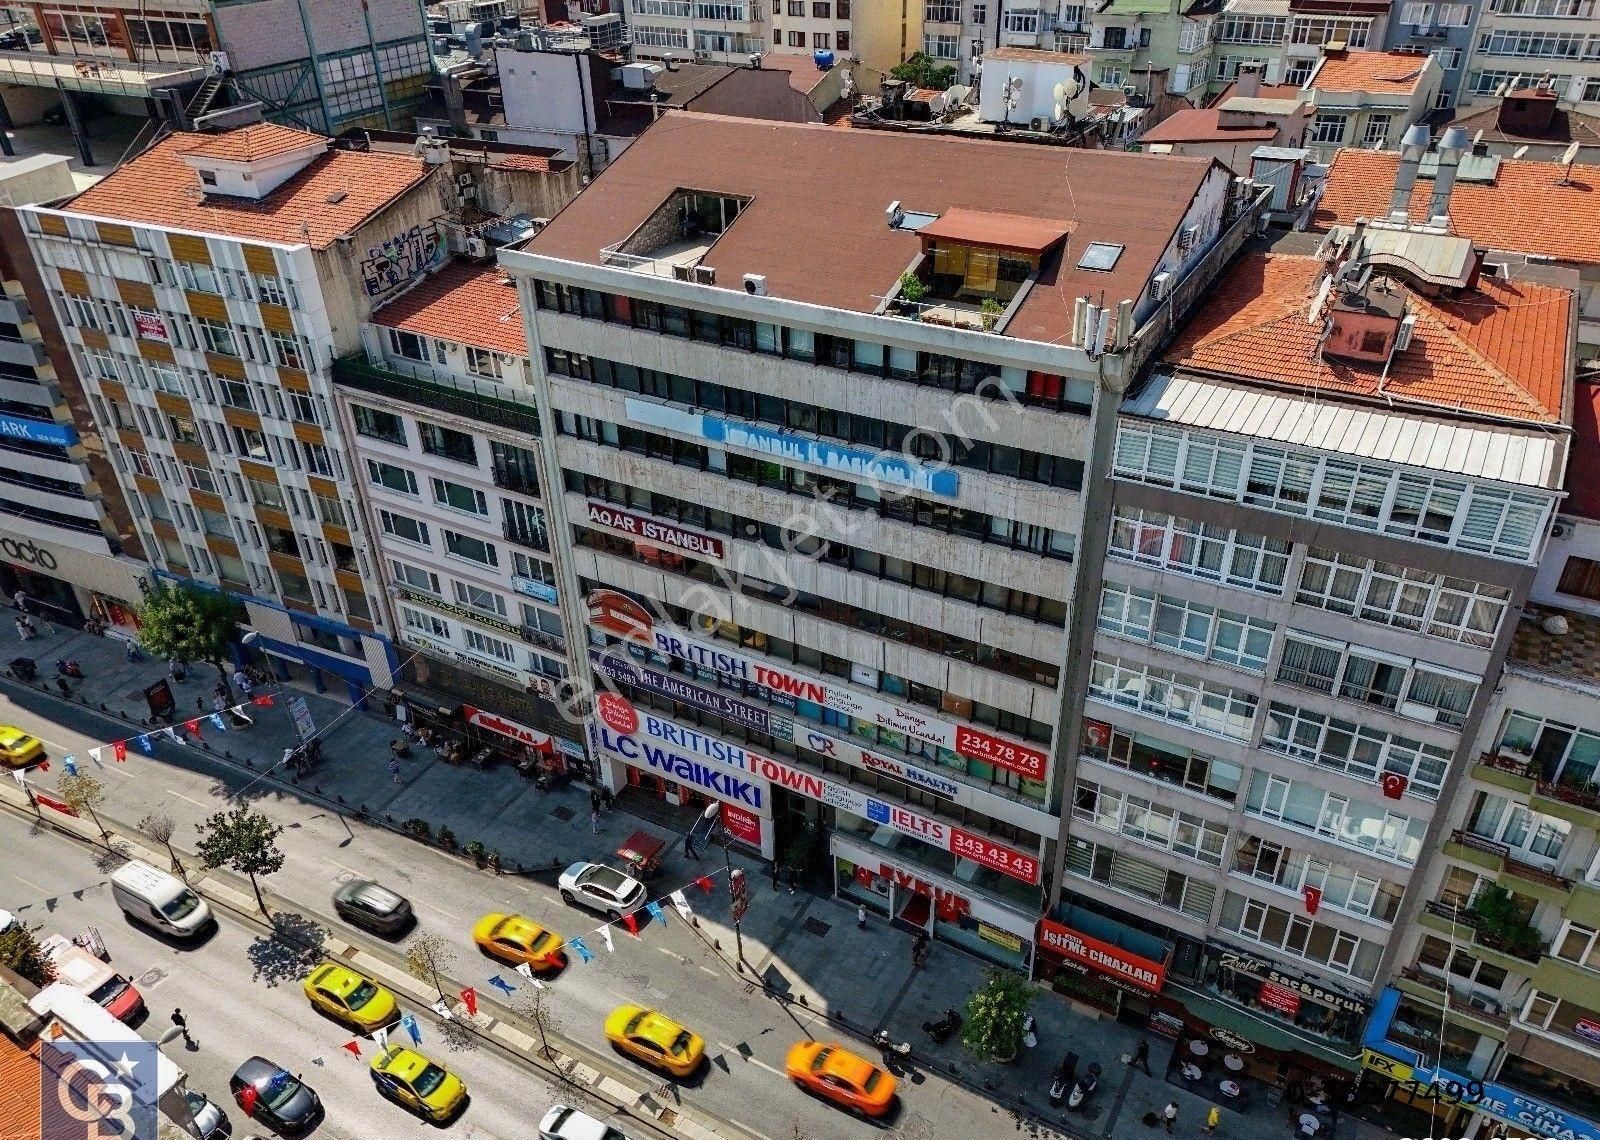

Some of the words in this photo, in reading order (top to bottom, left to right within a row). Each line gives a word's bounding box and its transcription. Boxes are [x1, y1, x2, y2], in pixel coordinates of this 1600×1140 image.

[588, 504, 637, 533] AQAR
[655, 632, 747, 678] BRITISH
[753, 664, 824, 704] TOWN
[638, 667, 658, 686] THE
[662, 676, 720, 709] AMERICAN
[725, 697, 767, 726] STREET
[875, 713, 907, 732] Dilimin
[894, 707, 927, 726] Dünya
[601, 727, 639, 759] LC
[646, 716, 745, 769] BRITISH
[745, 751, 823, 799] TOWN
[961, 732, 991, 754] 234
[995, 743, 1015, 761] 78
[1019, 752, 1040, 769] 78
[892, 808, 943, 839] IELTS
[955, 834, 984, 854] 343
[988, 848, 1008, 864] 43
[1012, 857, 1033, 874] 43
[1043, 929, 1087, 957] İŞİTME
[1089, 948, 1158, 986] CİHAZLARI
